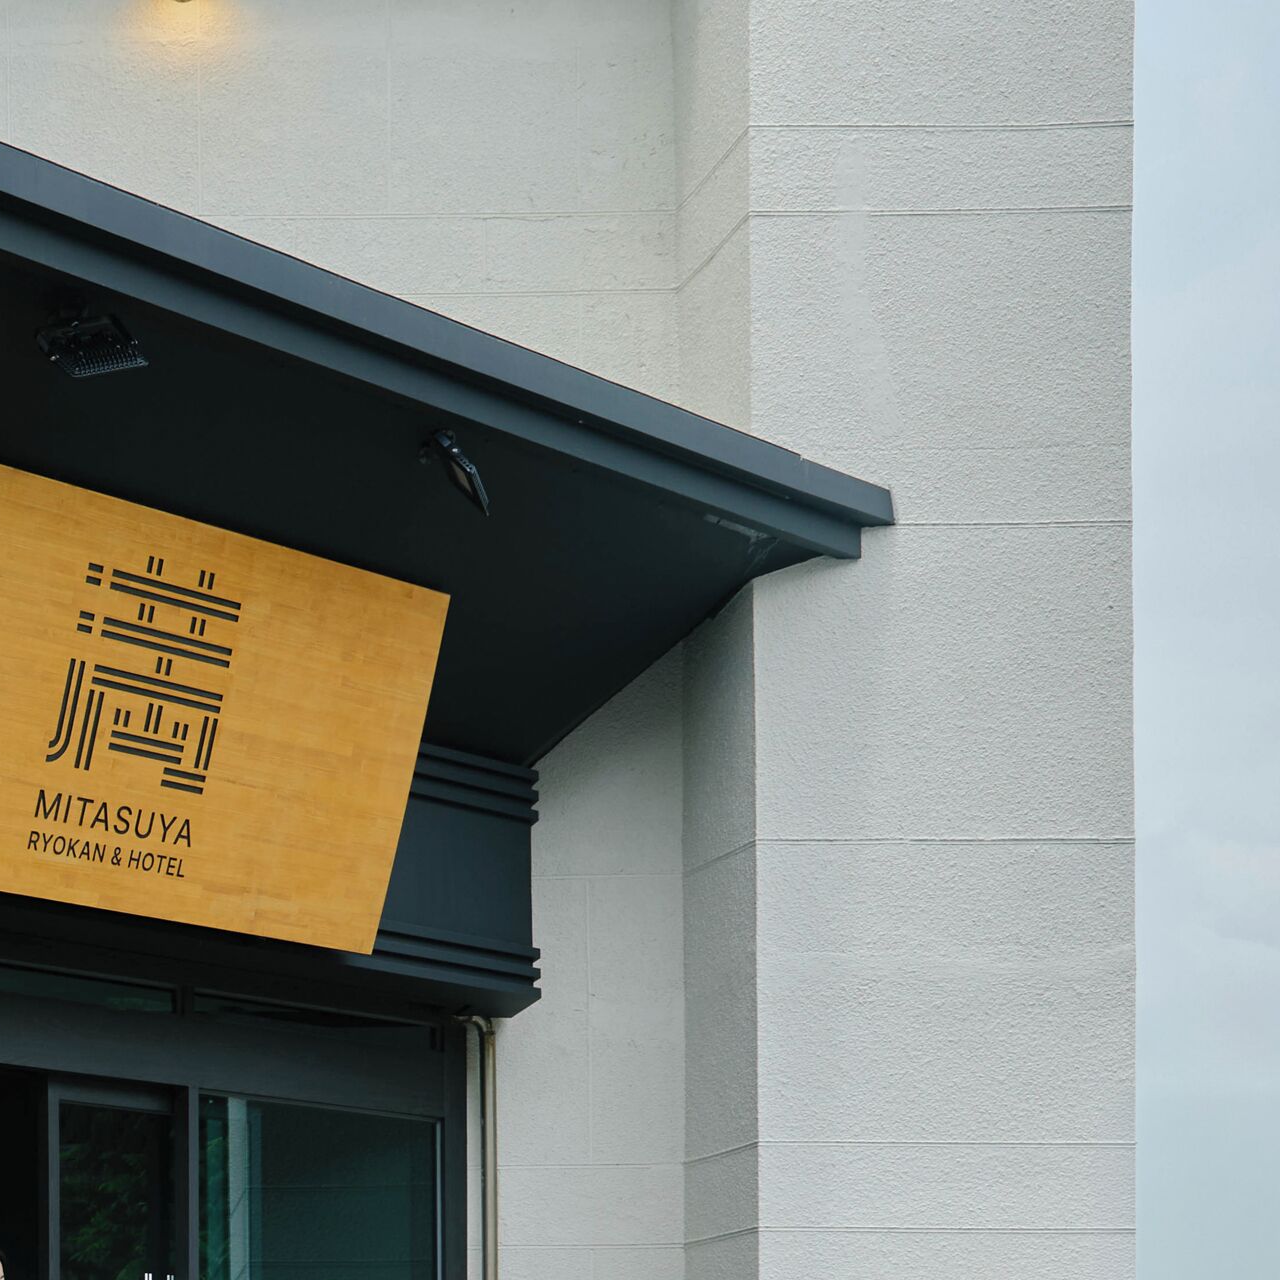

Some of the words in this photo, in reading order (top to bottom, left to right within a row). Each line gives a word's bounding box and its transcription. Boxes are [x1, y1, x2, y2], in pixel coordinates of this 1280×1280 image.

[34, 789, 192, 848] MITASUYA
[26, 830, 107, 864] RYOKAN
[110, 847, 122, 867] &
[127, 849, 185, 878] HOTEL
